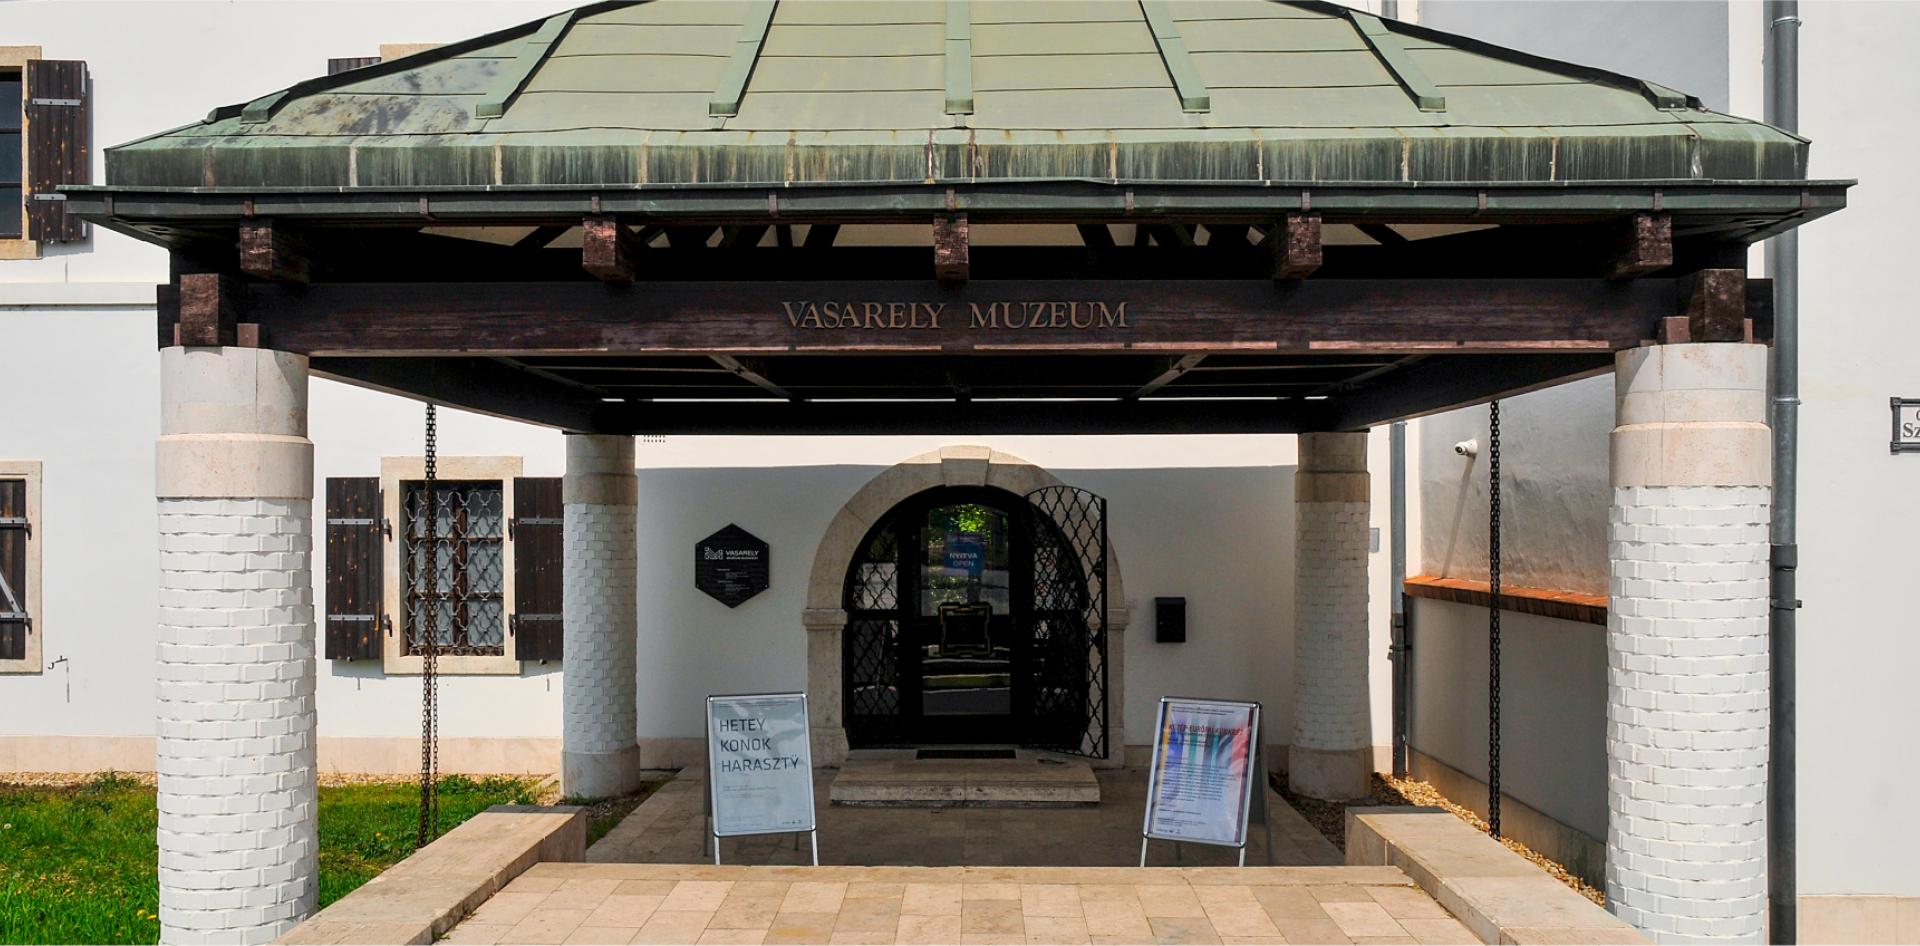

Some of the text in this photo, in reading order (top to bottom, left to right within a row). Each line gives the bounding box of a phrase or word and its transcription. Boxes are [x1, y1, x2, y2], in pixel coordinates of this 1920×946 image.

[782, 301, 1128, 329] VASARELY MUZEUM
[719, 717, 766, 732] HETEY
[720, 738, 772, 753] KONOK
